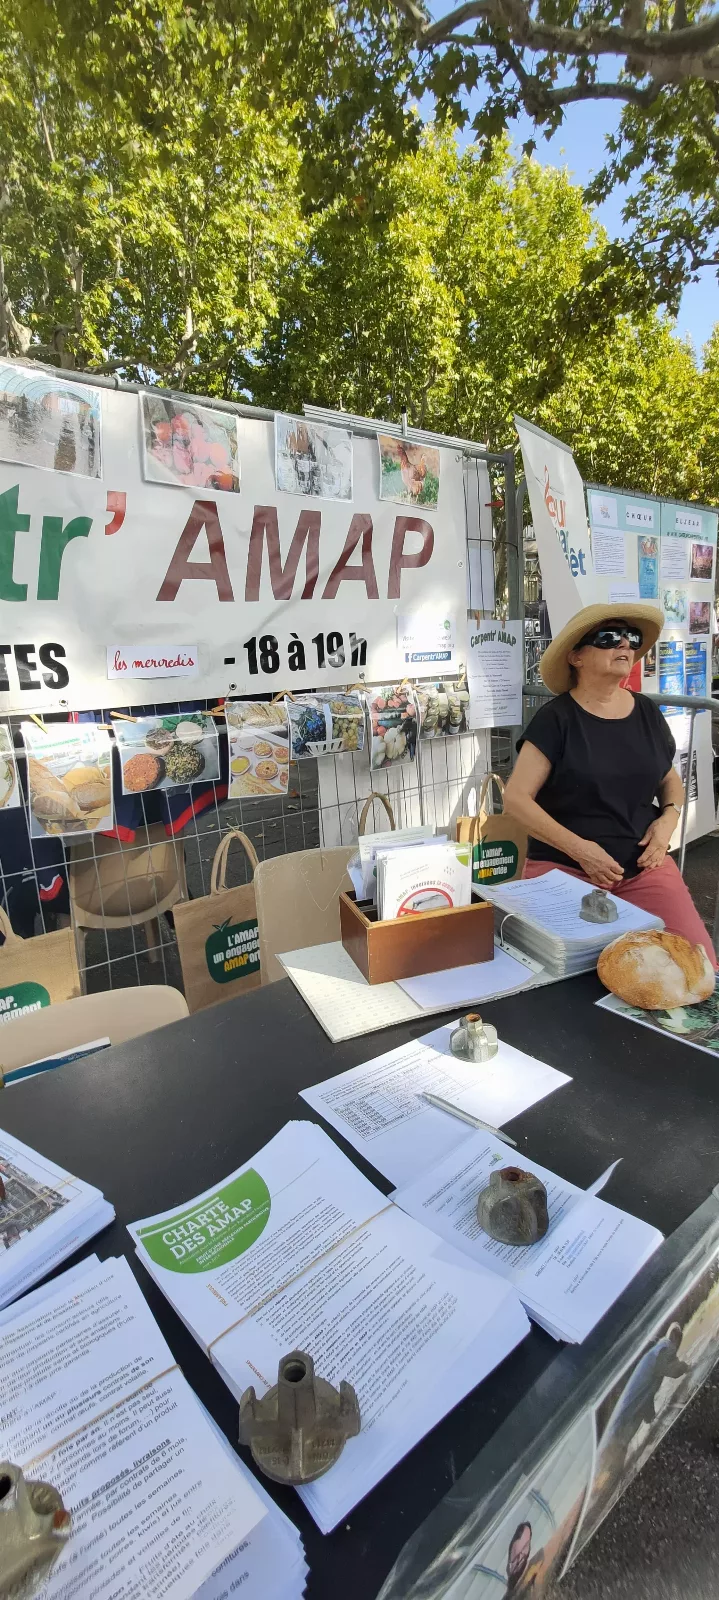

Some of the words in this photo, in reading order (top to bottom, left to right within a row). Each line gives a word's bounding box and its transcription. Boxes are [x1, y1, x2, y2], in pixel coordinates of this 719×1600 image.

[156, 500, 435, 602] AMAP
[112, 650, 128, 672] les
[131, 652, 195, 669] mercredis
[243, 635, 280, 675] 18
[287, 632, 306, 672] à
[479, 854, 514, 869] engagement
[213, 951, 225, 964] un
[225, 939, 260, 959] engage
[162, 1200, 230, 1246] CHARTE
[169, 1232, 207, 1261] DES
[208, 1198, 254, 1239] AMAP
